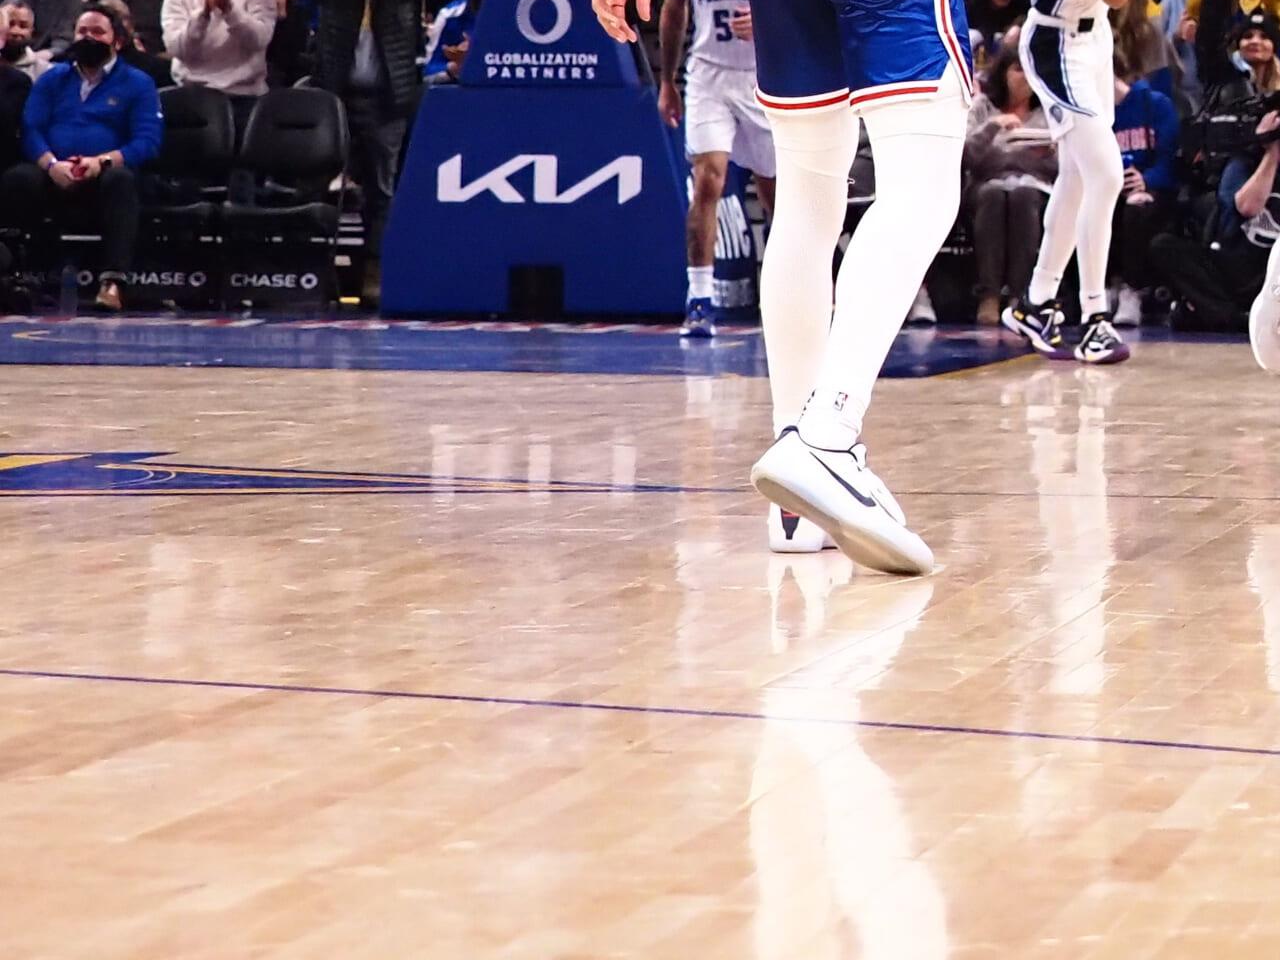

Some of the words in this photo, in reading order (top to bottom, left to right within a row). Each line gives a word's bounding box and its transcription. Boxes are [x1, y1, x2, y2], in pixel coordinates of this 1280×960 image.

[713, 9, 740, 42] 5
[484, 52, 599, 66] GLOBALIZATION
[487, 66, 596, 80] PARTNERS
[437, 153, 643, 205] KIA
[230, 273, 297, 288] CHASE
